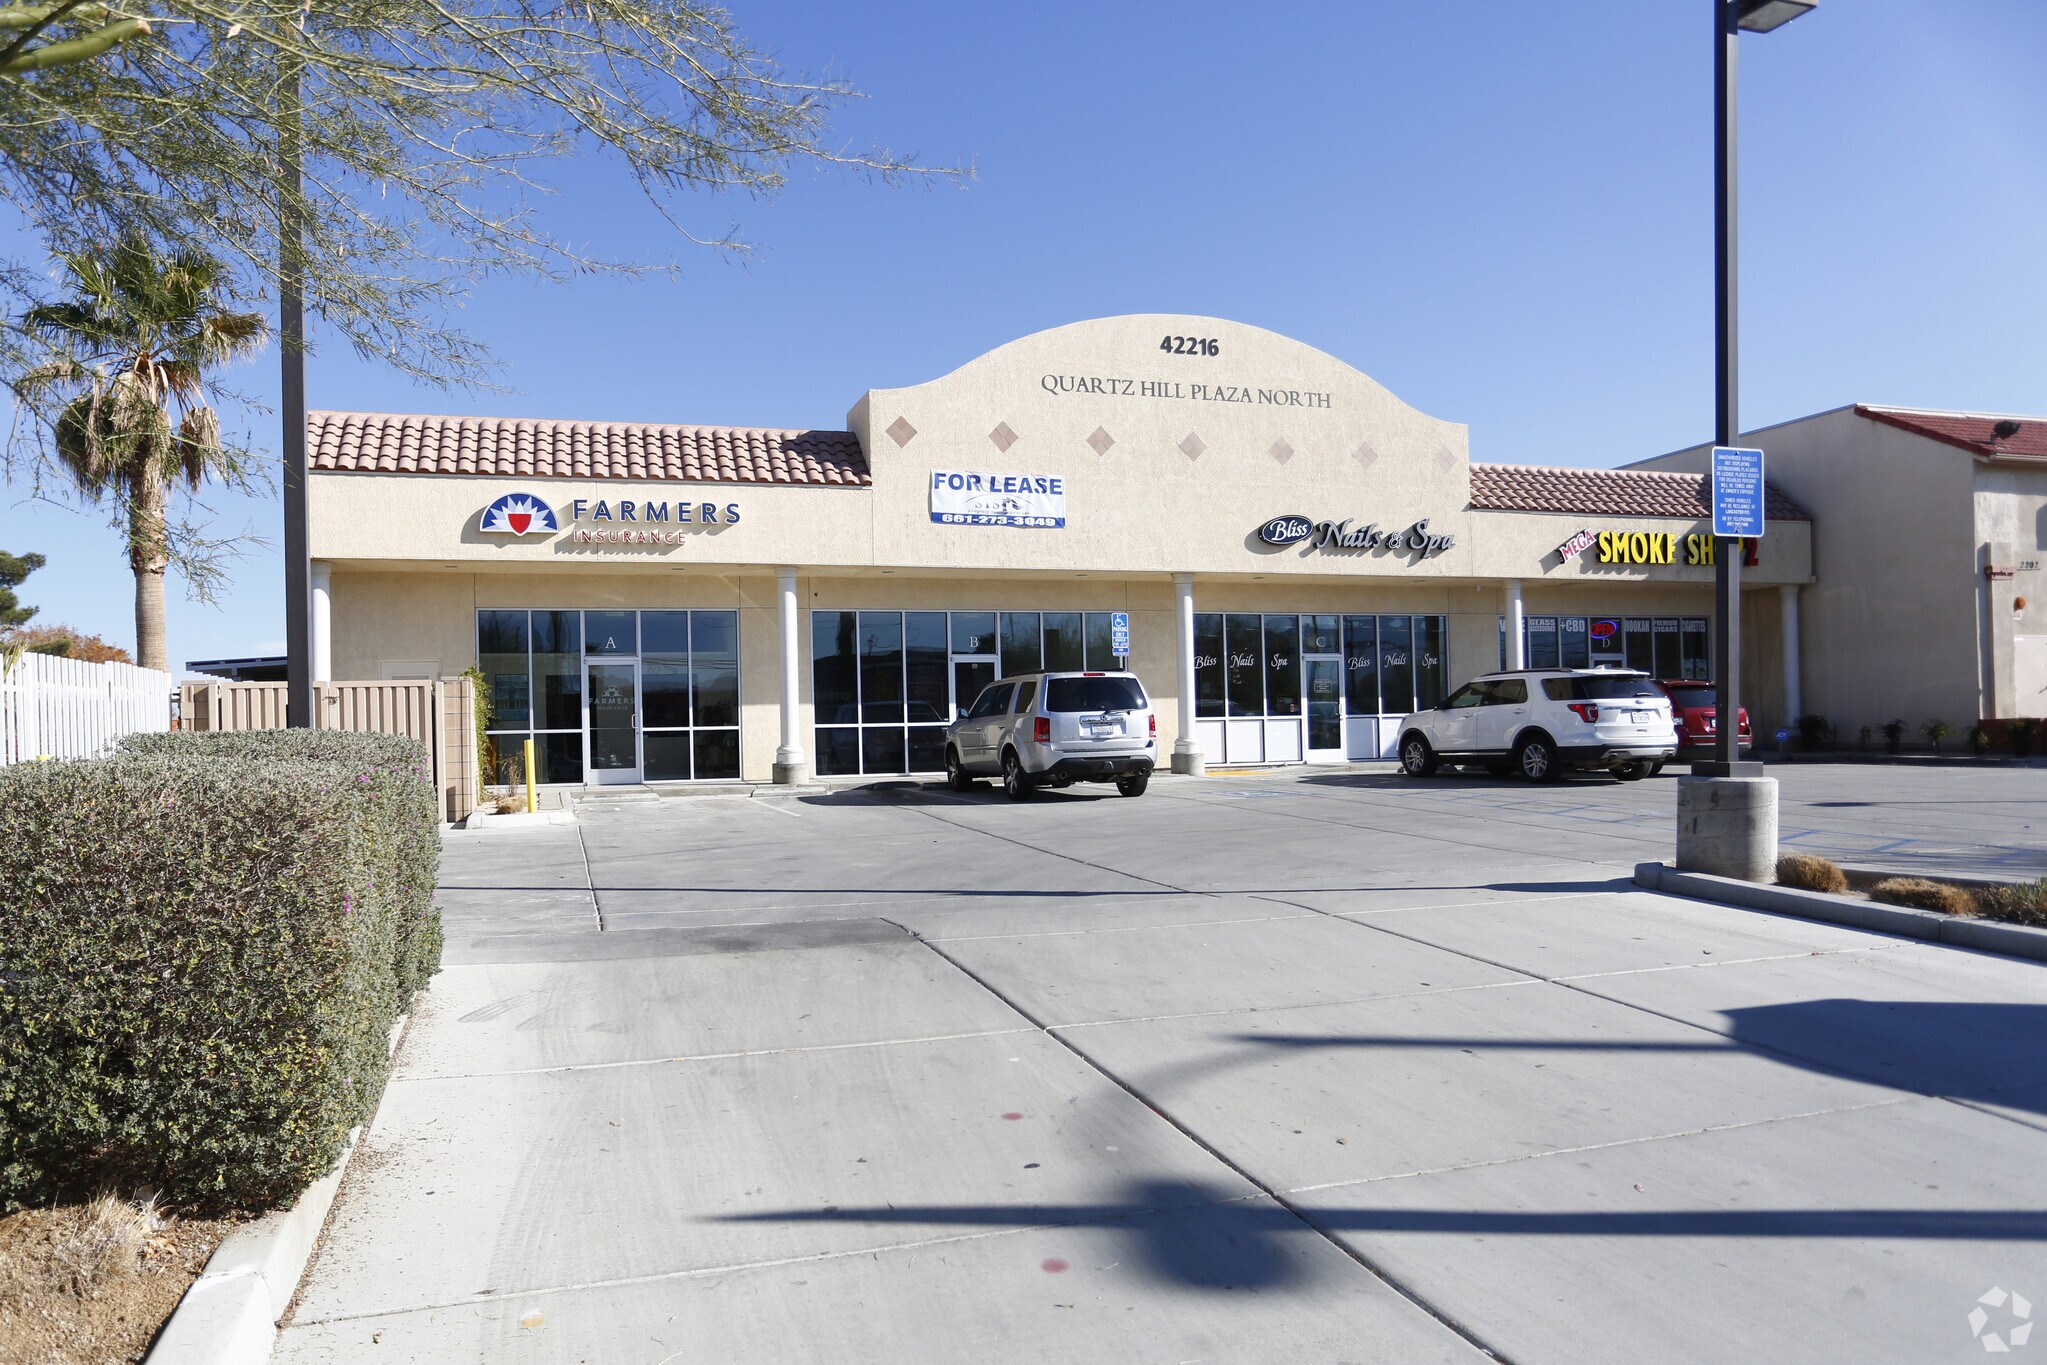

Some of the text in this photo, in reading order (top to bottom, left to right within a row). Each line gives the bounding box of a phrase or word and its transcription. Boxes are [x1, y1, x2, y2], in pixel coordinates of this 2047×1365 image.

[1160, 335, 1219, 357] 42216
[1041, 374, 1332, 409] QUARTZ HILL PLAZA NORTH
[934, 472, 1063, 496] FOR LEASE
[572, 498, 741, 525] FARMERS
[941, 514, 1056, 527] 661-273-3049
[573, 529, 687, 545] INSURANCE
[1270, 517, 1456, 559] Bliss Nails & Spa
[1561, 529, 1597, 562] MEGA
[1598, 530, 1677, 565] SMOKE
[1590, 623, 1615, 636] OPEN
[1625, 620, 1650, 632] HOOKAH
[1681, 620, 1706, 632] CIGARETTES
[605, 636, 617, 649] A
[969, 636, 979, 648] B
[1315, 636, 1325, 648] C
[1602, 638, 1611, 648] D
[1194, 653, 1289, 671] Bliss Nails Spa
[1348, 652, 1438, 670] Bliss Nails Spa
[589, 697, 635, 705] FARMERS
